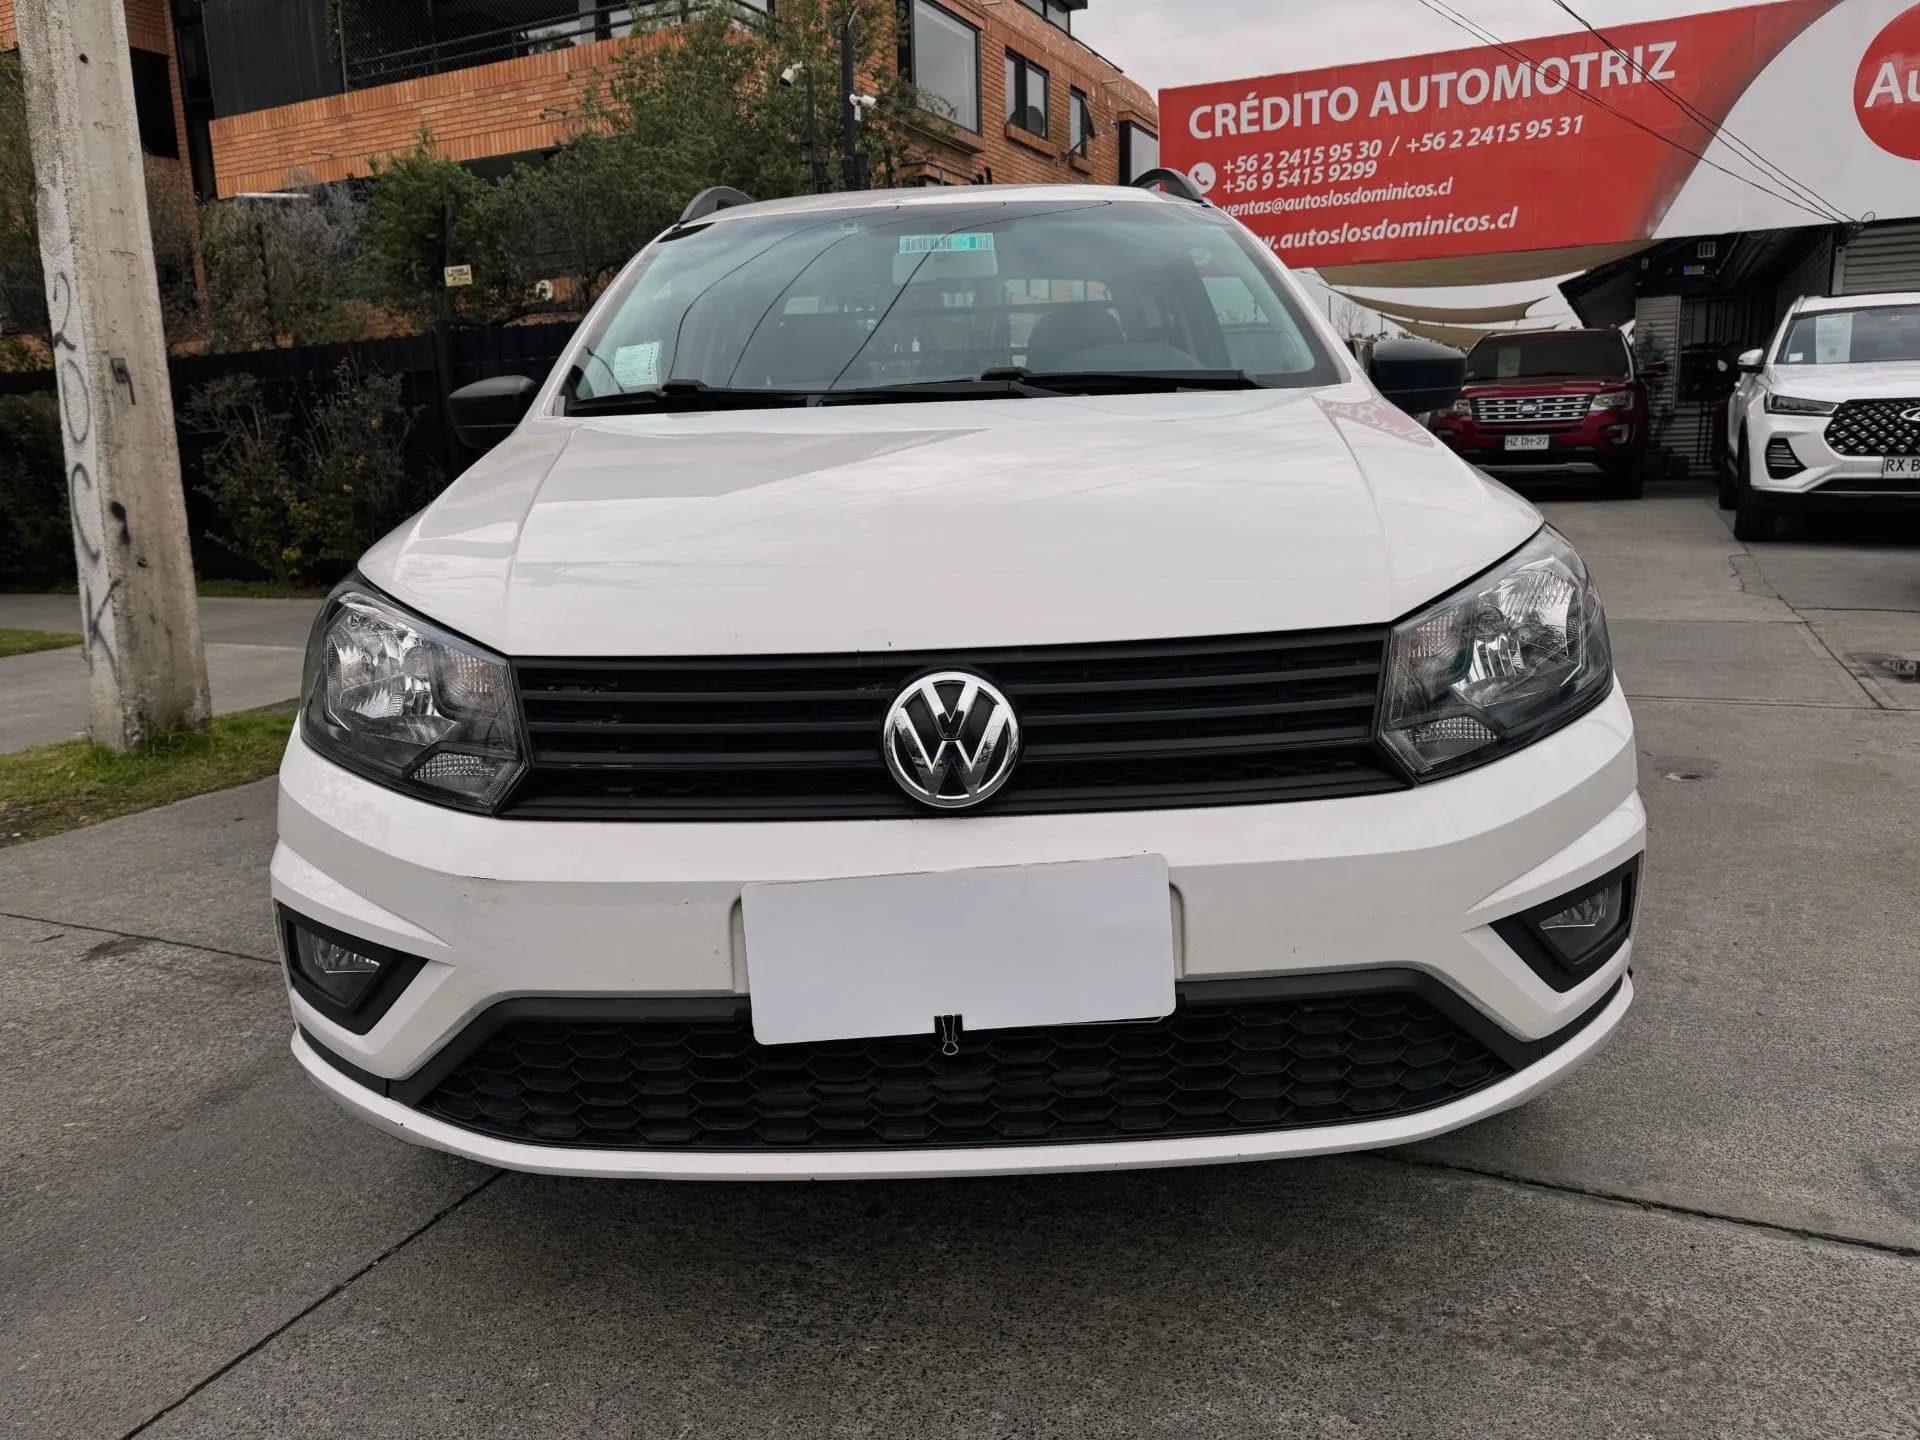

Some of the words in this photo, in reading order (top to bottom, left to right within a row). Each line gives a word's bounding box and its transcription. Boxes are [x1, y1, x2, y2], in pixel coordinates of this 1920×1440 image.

[1189, 91, 1359, 139] CRÉDITO
[1369, 41, 1678, 118] AUTOMOTRIZ
[1223, 154, 1258, 175] +56
[1261, 152, 1274, 171] 2
[1276, 146, 1325, 169] 2415
[1328, 142, 1352, 163] 95
[1356, 139, 1383, 160] 30
[1388, 136, 1400, 156] /
[1406, 131, 1446, 153] +56
[1449, 129, 1464, 149] 2
[1466, 122, 1521, 148] 2415
[1525, 118, 1552, 140] 95
[1556, 115, 1584, 136] 31
[1221, 176, 1453, 217] ventas@autoslosdominicos.cl
[1222, 173, 1258, 194] +56
[1261, 171, 1274, 191] 9
[1276, 165, 1325, 188] 5415
[1328, 160, 1377, 182] 9299
